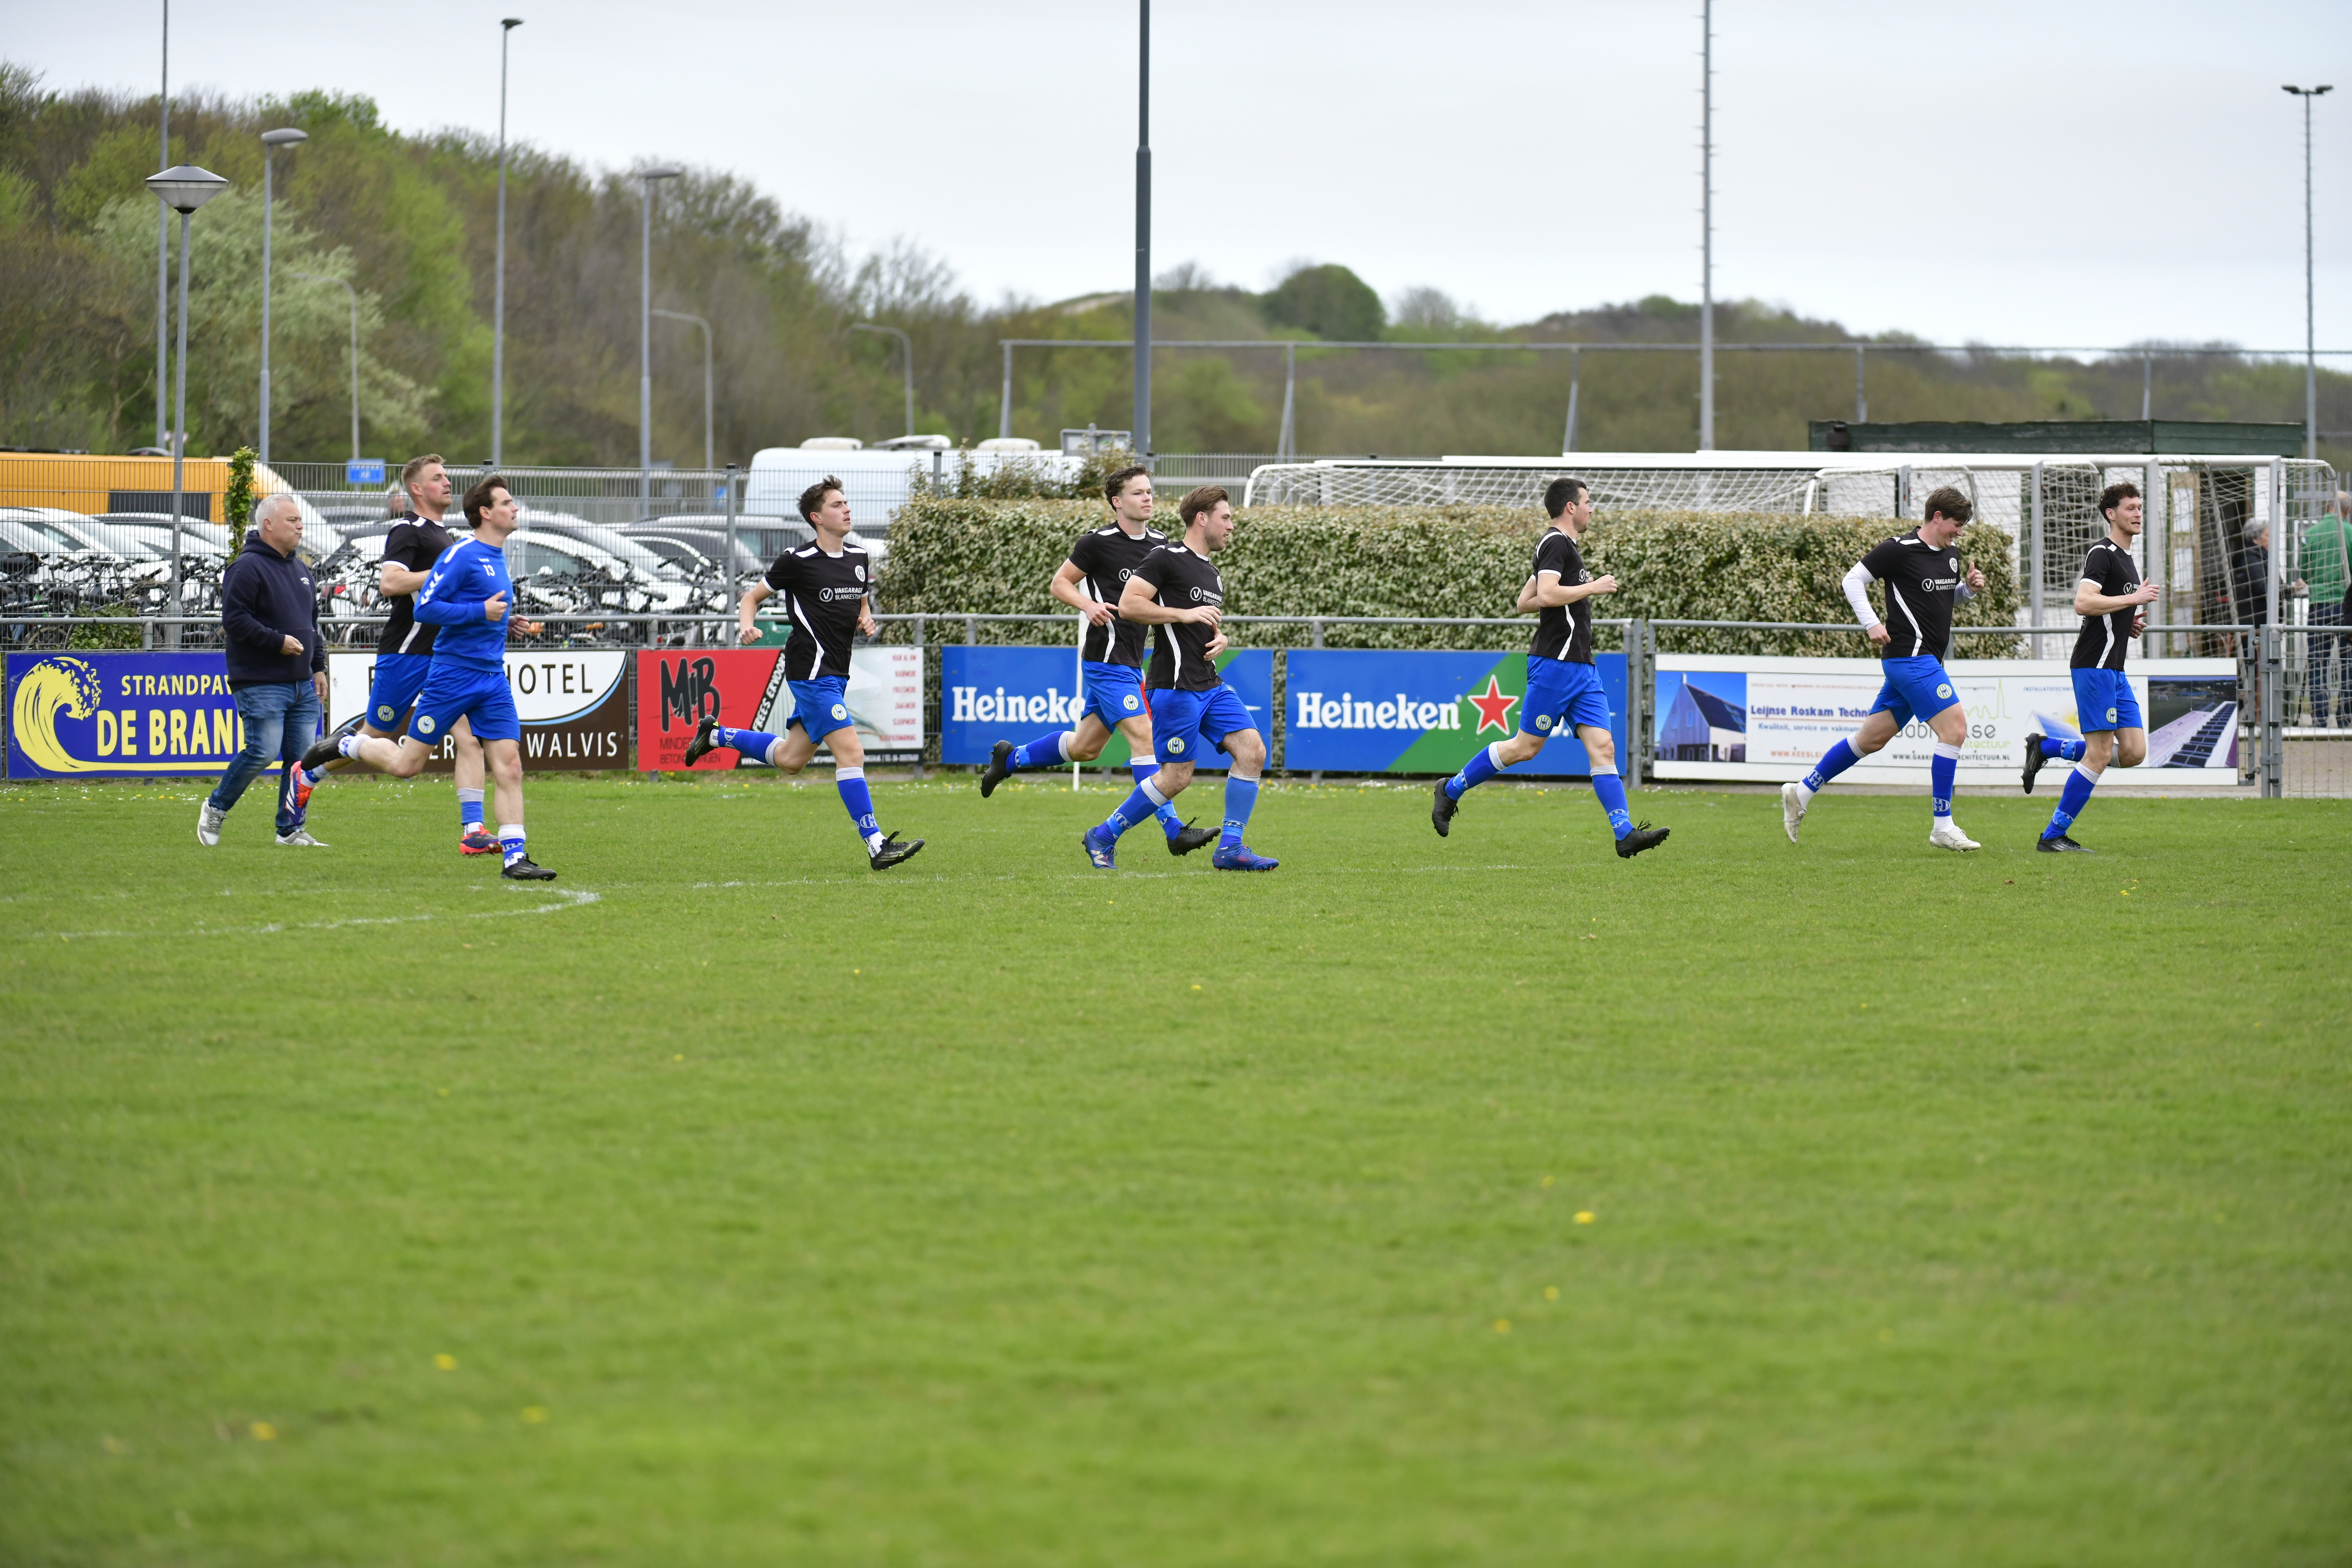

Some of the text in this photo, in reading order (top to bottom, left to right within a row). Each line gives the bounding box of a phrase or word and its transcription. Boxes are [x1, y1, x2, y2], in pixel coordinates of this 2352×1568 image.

[483, 564, 496, 577] 13
[752, 697, 771, 733] FREES
[952, 686, 1087, 724] Heineke
[1296, 692, 1461, 730] Heineken
[1751, 705, 1871, 717] Leijnse Roskam Techni
[97, 708, 247, 757] DE BRAN
[526, 731, 618, 758] WALVIS
